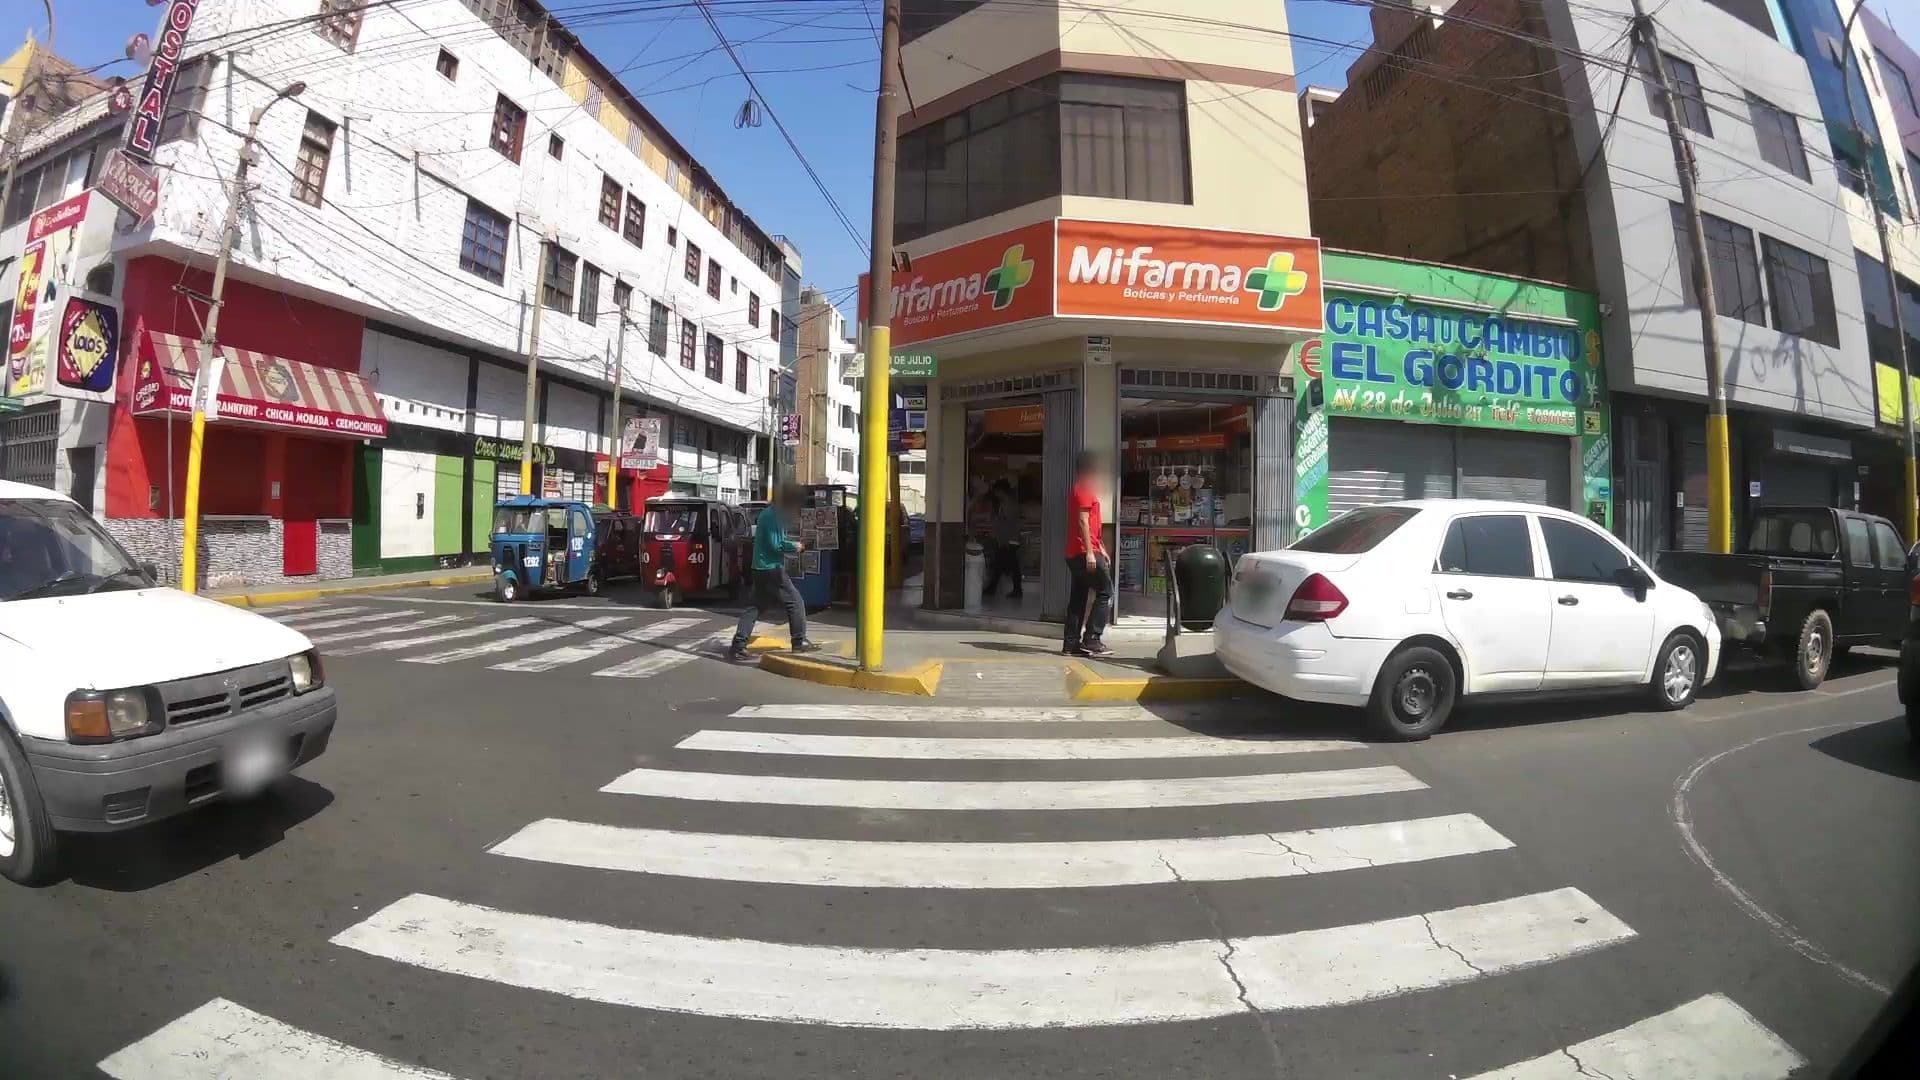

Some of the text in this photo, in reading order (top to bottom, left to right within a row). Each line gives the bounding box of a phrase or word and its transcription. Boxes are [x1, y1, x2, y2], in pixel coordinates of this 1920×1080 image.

[132, 0, 199, 152] OSTAL
[1068, 245, 1241, 292] Mifarma
[1123, 287, 1240, 305] Boticas y Perfumería
[1325, 297, 1435, 343] CASA
[1457, 314, 1581, 363] CAMBIO
[894, 355, 932, 365] DE JULIO
[1331, 341, 1582, 403] EL GORDITO
[217, 400, 258, 417] RANKFURT
[265, 407, 294, 423] CHICHA
[296, 412, 329, 428] MORADA
[1360, 390, 1386, 412] 28
[1391, 389, 1413, 414] de
[1420, 392, 1462, 418] Julio
[687, 552, 704, 564] 40
